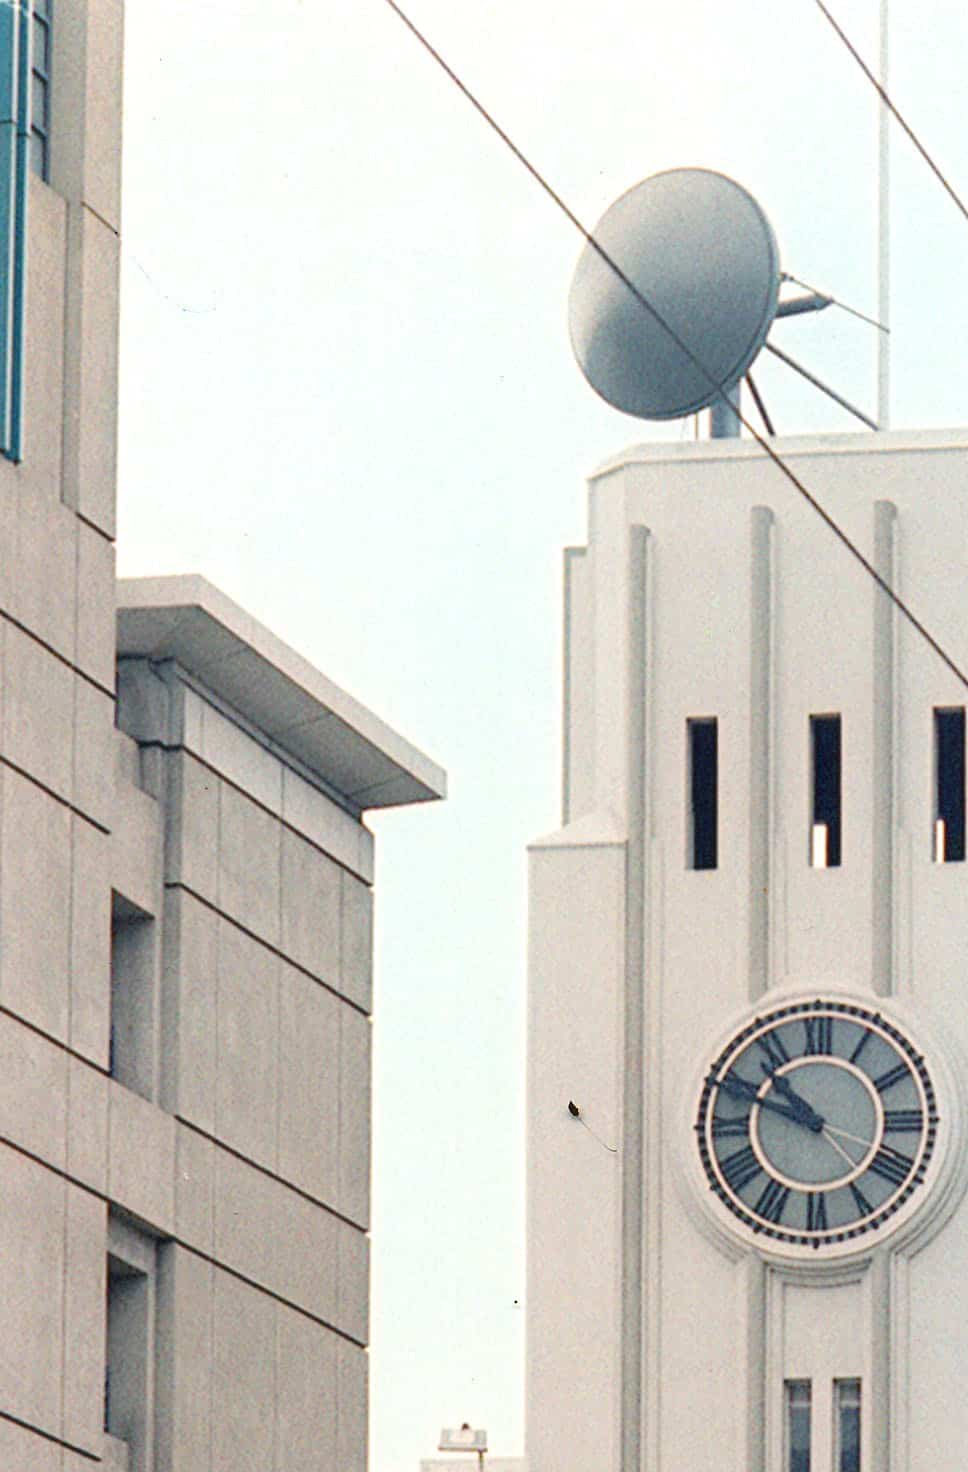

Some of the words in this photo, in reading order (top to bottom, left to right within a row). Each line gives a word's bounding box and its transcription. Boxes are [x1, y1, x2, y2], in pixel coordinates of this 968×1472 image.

[803, 1016, 832, 1055] XII
[849, 1027, 872, 1063] I
[874, 1062, 911, 1093] II
[884, 1109, 923, 1132] III
[848, 1182, 875, 1218] V
